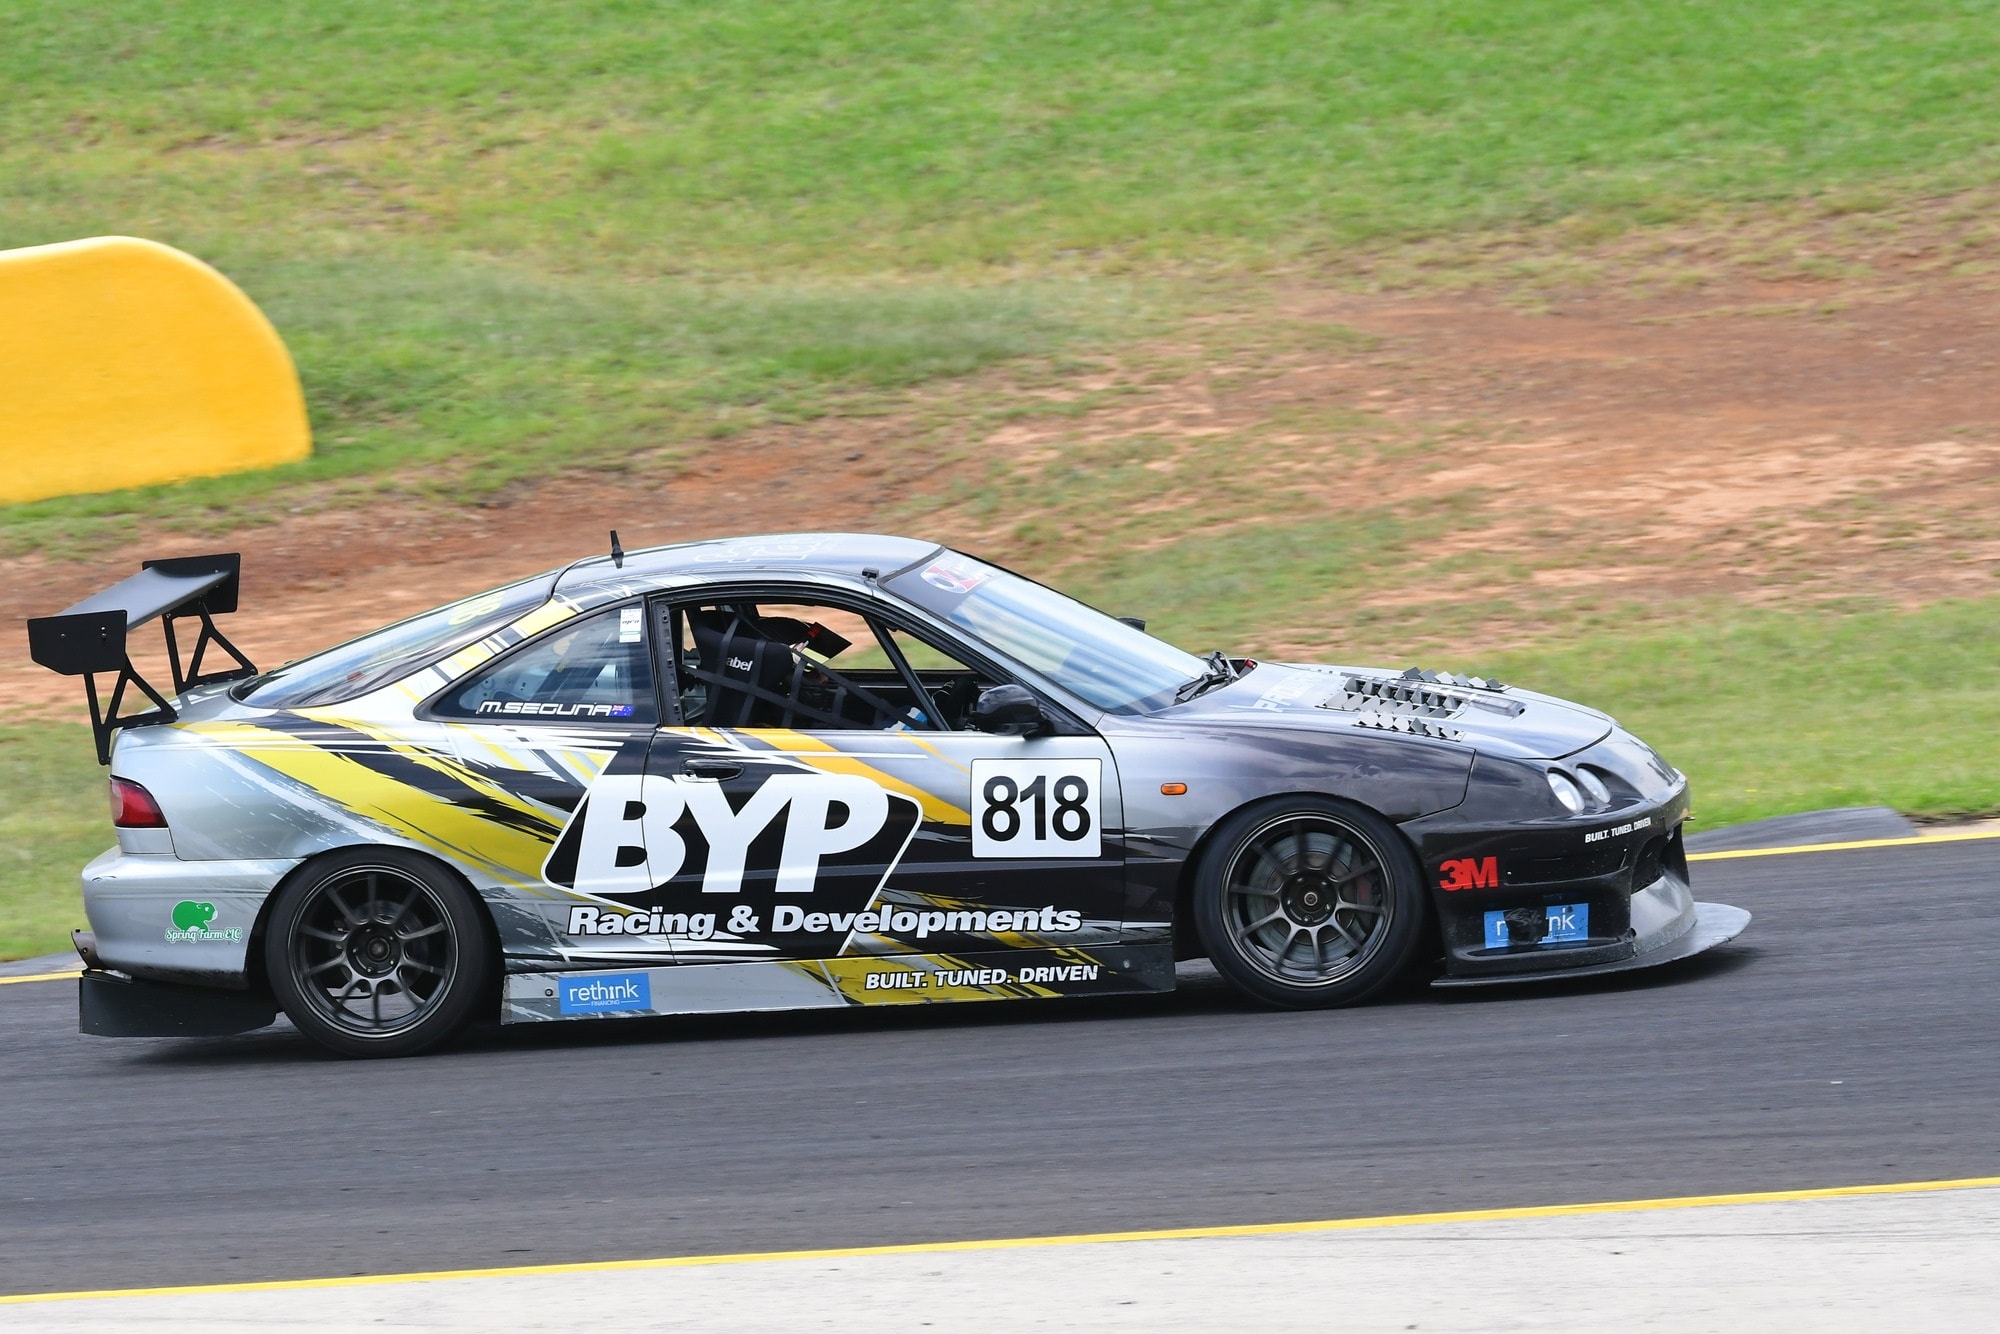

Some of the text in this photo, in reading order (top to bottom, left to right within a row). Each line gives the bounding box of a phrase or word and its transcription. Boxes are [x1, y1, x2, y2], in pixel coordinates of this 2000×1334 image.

[726, 656, 753, 672] abel
[478, 701, 613, 717] M.SEGUNA
[981, 775, 1091, 841] 818
[572, 773, 889, 894] BYP
[1584, 829, 1610, 844] BUILT.
[1610, 823, 1634, 838] TUNED.
[1439, 856, 1498, 892] 3M
[568, 904, 1082, 940] Racing & Developments
[166, 927, 242, 943] Spring Farm ELC
[865, 964, 1099, 990] BUILT. TUNED. DRIVEN
[569, 978, 639, 1002] rethink
